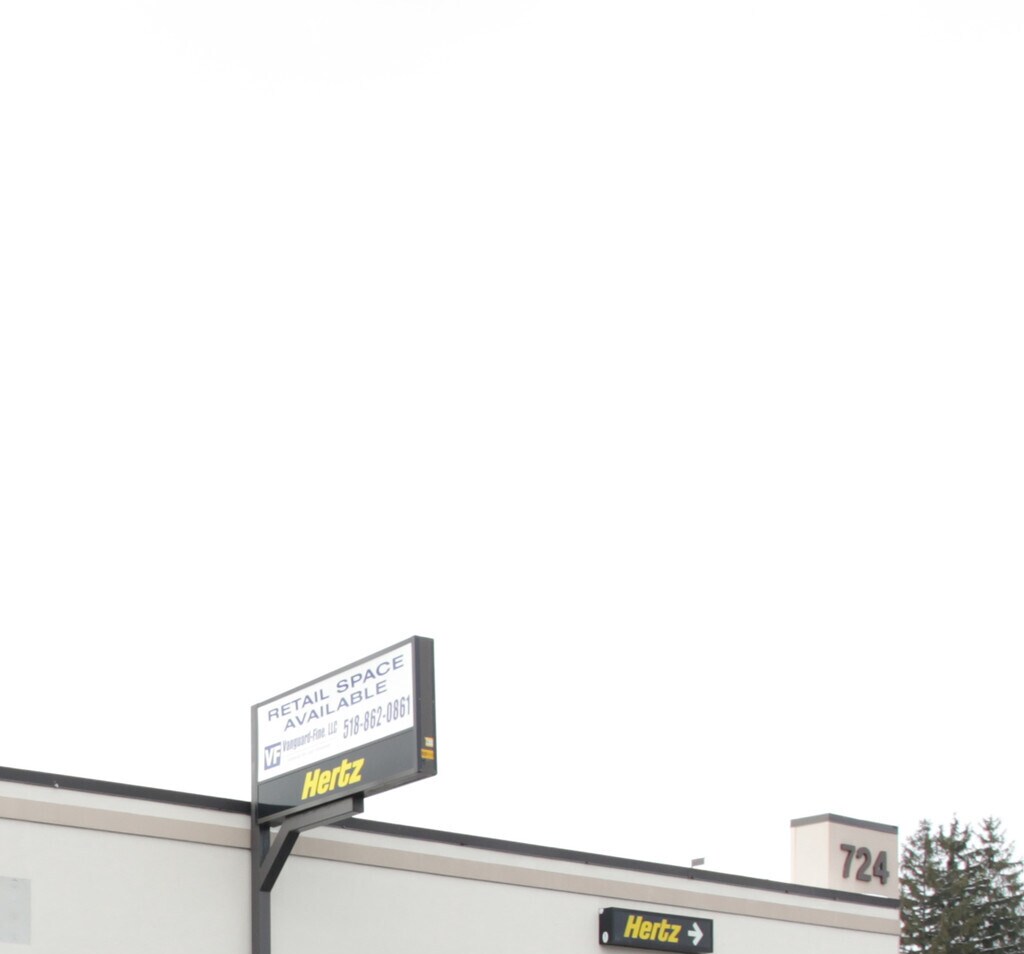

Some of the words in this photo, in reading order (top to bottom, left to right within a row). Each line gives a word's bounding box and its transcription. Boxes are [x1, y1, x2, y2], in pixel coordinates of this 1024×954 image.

[268, 689, 330, 721] RETAIL
[336, 654, 404, 693] SPACE
[284, 679, 388, 732] AVAILABLE
[328, 720, 338, 736] LLC
[343, 695, 410, 739] 518-862-0861
[301, 758, 365, 800] Hertz
[840, 843, 890, 885] 724
[623, 915, 682, 943] Hertz
